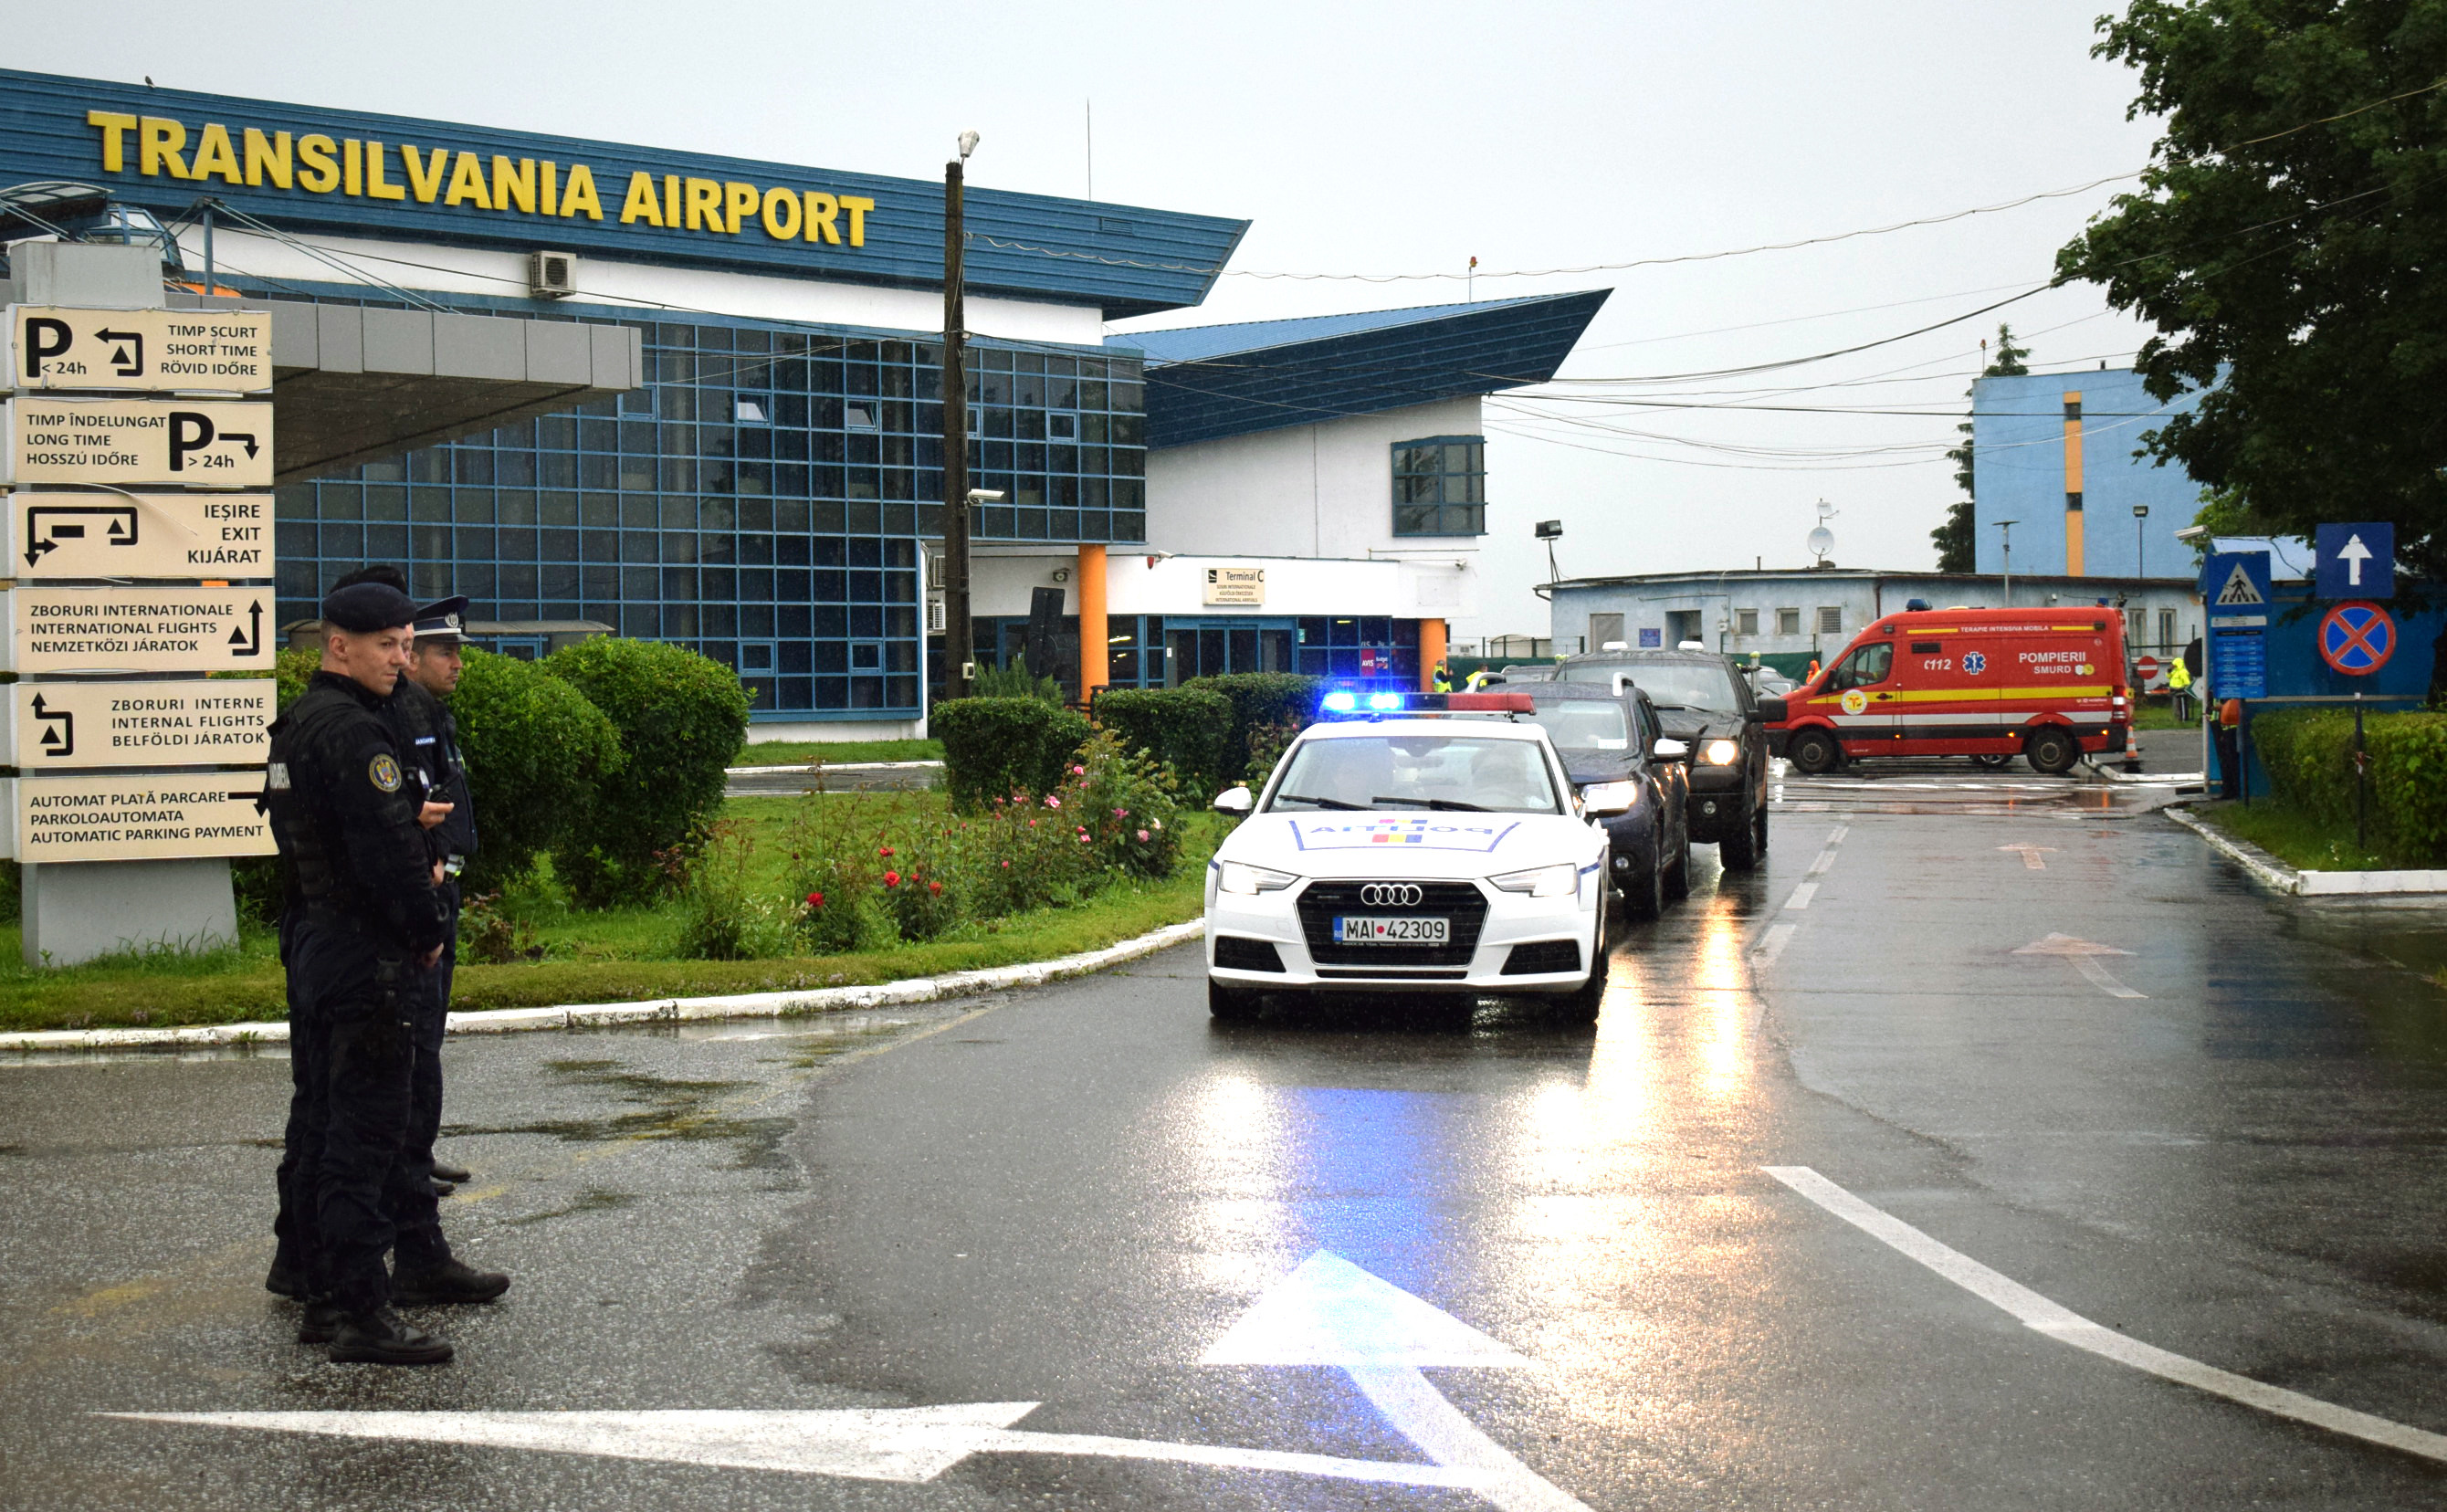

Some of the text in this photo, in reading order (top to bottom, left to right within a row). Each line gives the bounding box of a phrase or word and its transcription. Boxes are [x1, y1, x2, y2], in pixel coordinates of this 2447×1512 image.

[88, 109, 875, 248] TRANSILVANIA AIRPORT
[168, 325, 257, 338] TIMP SCURT
[26, 317, 73, 378] P
[166, 343, 257, 357] SHORT TIME
[57, 362, 88, 375] 24h
[161, 360, 257, 375] RÖVID IDŐRE
[26, 413, 166, 428] TIMP ÎNDELUNGAT
[26, 434, 111, 446] LONG TIME
[169, 411, 215, 472] P
[26, 451, 139, 466] HOSSZÚ IDŐRE
[203, 455, 235, 468] 24h
[222, 527, 261, 541] EXIT
[187, 545, 261, 564] KIJÁRAT
[1225, 570, 1264, 583] Terminal C
[30, 604, 234, 617] ZBORURI INTERNATIONALE
[30, 622, 217, 635] INTERNATIONAL FLIGHTS
[31, 638, 198, 653] NEMZETKÖZI JÁRATOK
[2019, 652, 2086, 663] POMPIERII
[1930, 659, 1951, 671] 112
[2034, 666, 2072, 674] SMURD
[111, 698, 265, 711] ZBORURI INTERNE
[111, 715, 265, 729] INTERNAL FLIGHTS
[112, 731, 265, 747] BELFÖLDI JÁRATOK
[30, 790, 226, 808] AUTOMAT PLATĂ PARCARE
[30, 810, 184, 825] PARKOLOAUTOMATA
[30, 825, 264, 844] AUTOMATIC PARKING PAYMENT
[1333, 929, 1342, 938] RO
[1346, 920, 1444, 940] MAI 42309
